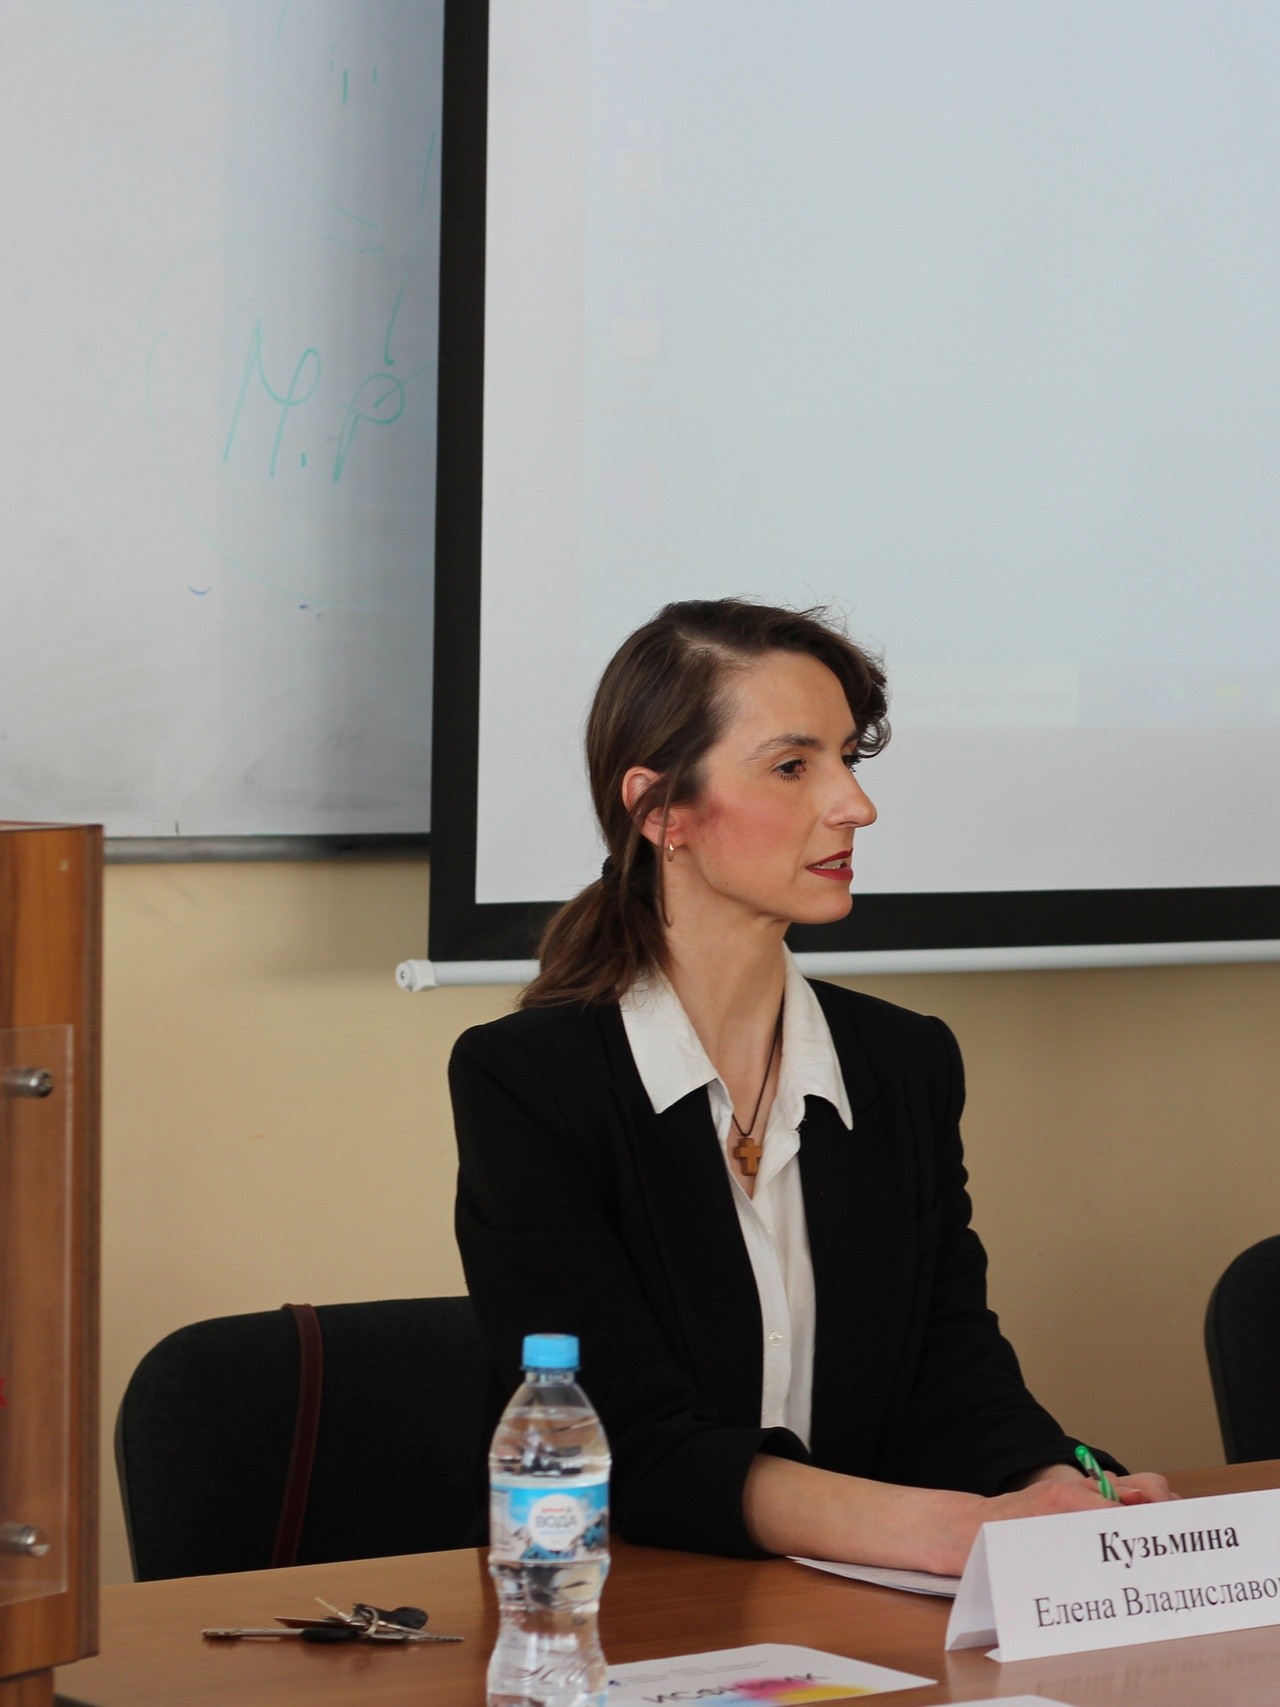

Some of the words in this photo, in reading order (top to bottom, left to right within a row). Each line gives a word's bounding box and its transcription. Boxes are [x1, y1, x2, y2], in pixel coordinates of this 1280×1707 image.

[535, 1515, 577, 1528] ВОДА
[1098, 1526, 1240, 1569] Кузьмина
[1034, 1597, 1116, 1628] Елена
